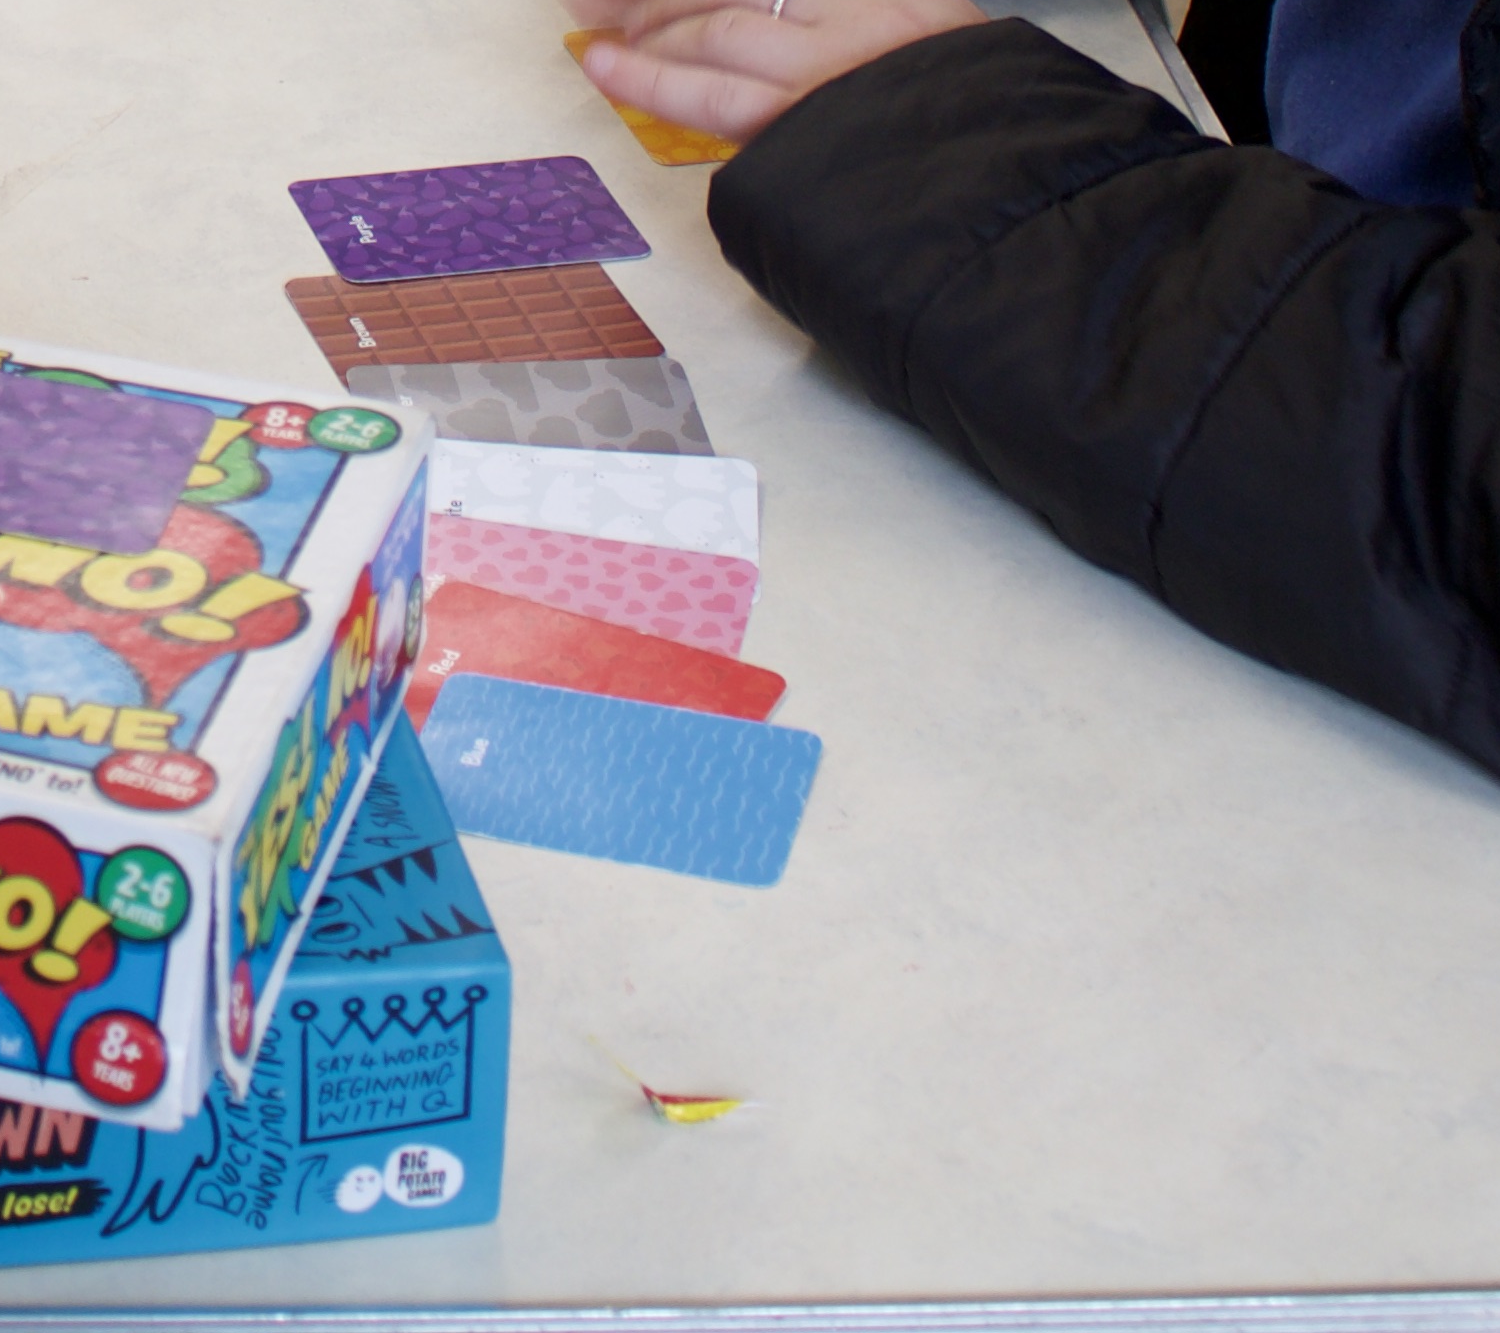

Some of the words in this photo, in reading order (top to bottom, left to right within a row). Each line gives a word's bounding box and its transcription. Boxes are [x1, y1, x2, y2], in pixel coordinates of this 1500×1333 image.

[349, 213, 376, 245] Purple
[349, 316, 375, 350] Brown
[261, 427, 303, 441] YEARS
[265, 407, 306, 429] 8+
[327, 413, 385, 440] 2-6
[319, 429, 373, 450] PLAYERS
[445, 498, 465, 518] ite
[425, 574, 446, 602] ink
[429, 649, 462, 677] Red
[130, 753, 159, 774] ALL
[160, 761, 202, 785] NEW
[460, 738, 490, 768] Blue
[48, 770, 86, 795] to!
[105, 765, 199, 802] QUESTIONS!
[299, 731, 351, 873] GAME
[116, 862, 177, 908] 2-6
[107, 896, 167, 931] PLAYERS
[100, 1021, 144, 1065] 8+
[316, 1053, 355, 1077] SAY
[360, 1051, 376, 1069] 4
[382, 1038, 462, 1066] WORDS
[92, 1061, 138, 1093] YEARS
[317, 1062, 457, 1106] BEGINNING
[250, 1079, 293, 1149] your
[317, 1097, 409, 1130] WITH
[420, 1090, 455, 1114] Q
[400, 1149, 429, 1173] BIG
[244, 1148, 289, 1232] name
[397, 1169, 448, 1191] POTATO
[2, 1186, 80, 1221] lose!
